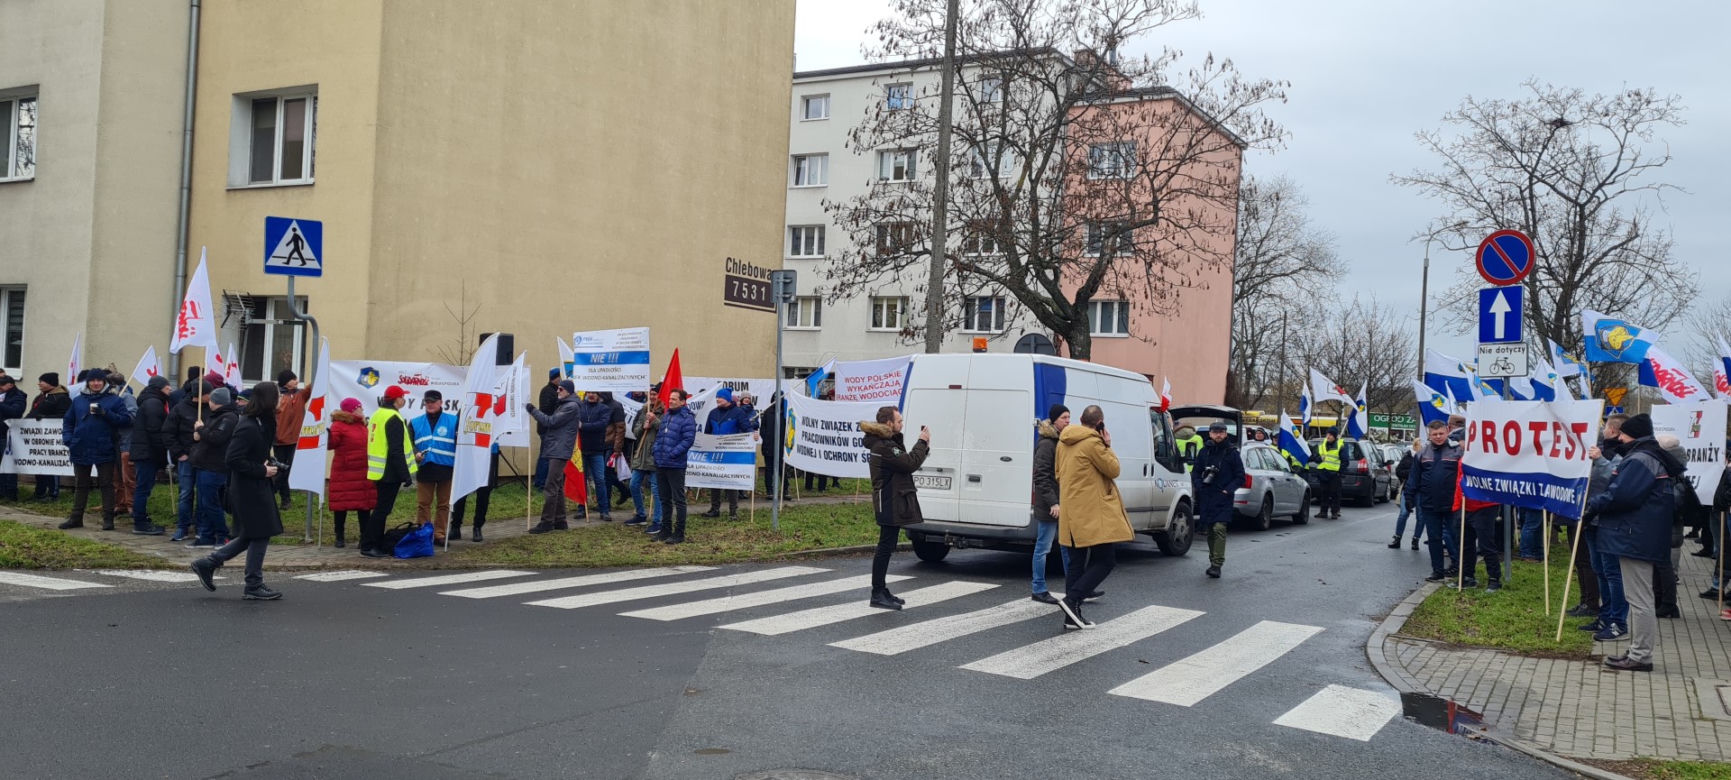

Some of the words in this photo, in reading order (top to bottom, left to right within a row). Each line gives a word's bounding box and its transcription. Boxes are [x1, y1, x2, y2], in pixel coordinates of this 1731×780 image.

[725, 257, 772, 281] Chlebowa
[1480, 346, 1492, 354] Nie
[1496, 346, 1526, 355] dotyczy
[590, 352, 606, 364] NIE
[868, 370, 902, 382] POLSKIE
[802, 416, 819, 429] WOLNY
[820, 420, 852, 434] ZWIĄZEK
[802, 434, 849, 447] PRACOWNIKÓW
[1466, 420, 1588, 461] PROTEST
[30, 448, 47, 456] PRACY
[688, 452, 708, 461] NIE
[796, 444, 817, 458] WODNEJ
[824, 450, 858, 462] OCHRONY
[914, 476, 924, 486] PO
[1466, 475, 1494, 491] WOLNE
[1494, 478, 1536, 498] ZWIĄZKI
[1538, 483, 1576, 504] ZAWODOWE
